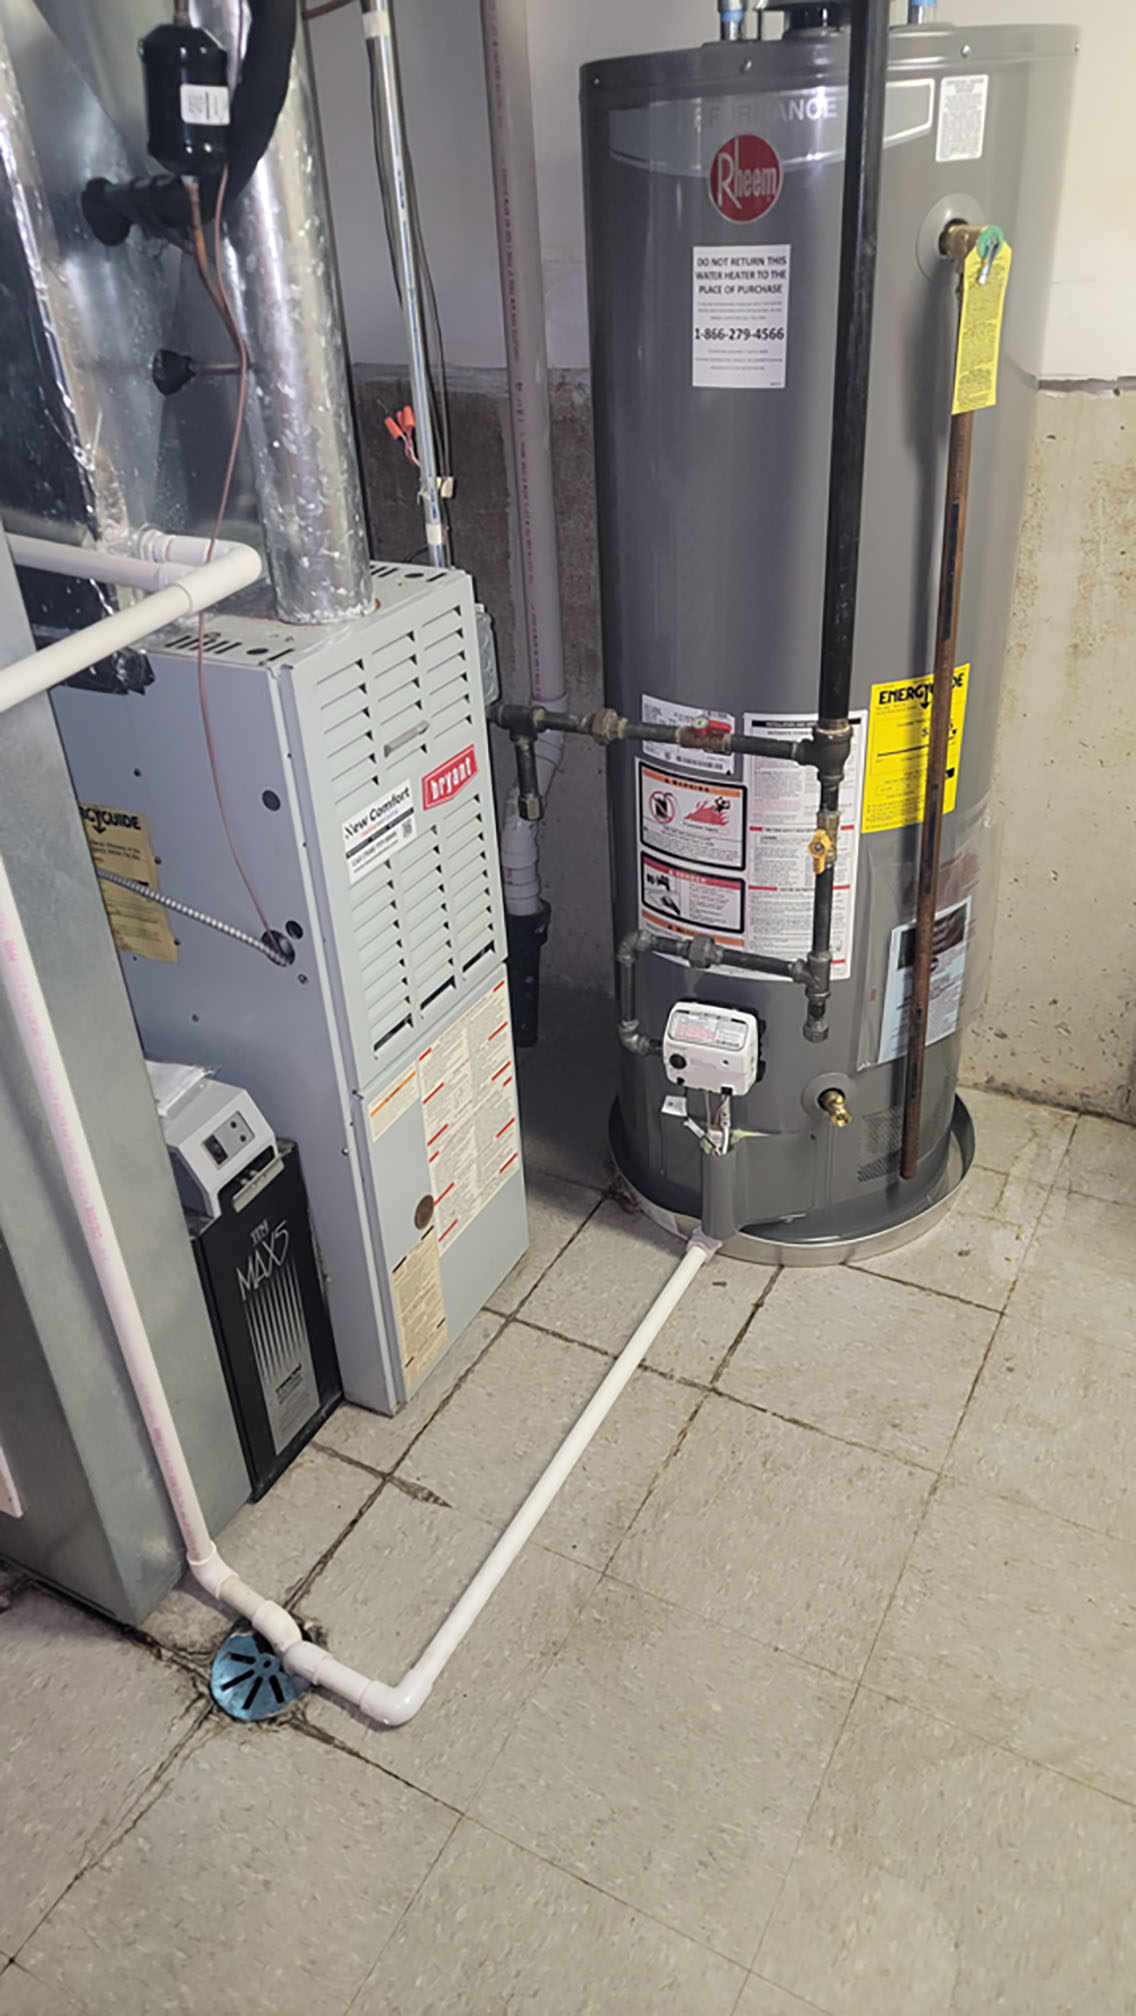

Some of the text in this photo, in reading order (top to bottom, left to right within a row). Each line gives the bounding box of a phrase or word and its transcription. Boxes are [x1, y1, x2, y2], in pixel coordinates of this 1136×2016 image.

[717, 135, 778, 209] Rheem
[697, 256, 787, 266] DO NOT RETURN THIS
[695, 269, 786, 279] WATER HEATER TO THE
[698, 284, 783, 294] PLACE OF PURCHASE
[695, 327, 785, 340] 1-866-279-4566
[430, 757, 472, 800] bryant
[344, 815, 368, 838] New
[369, 787, 410, 821] Comfort
